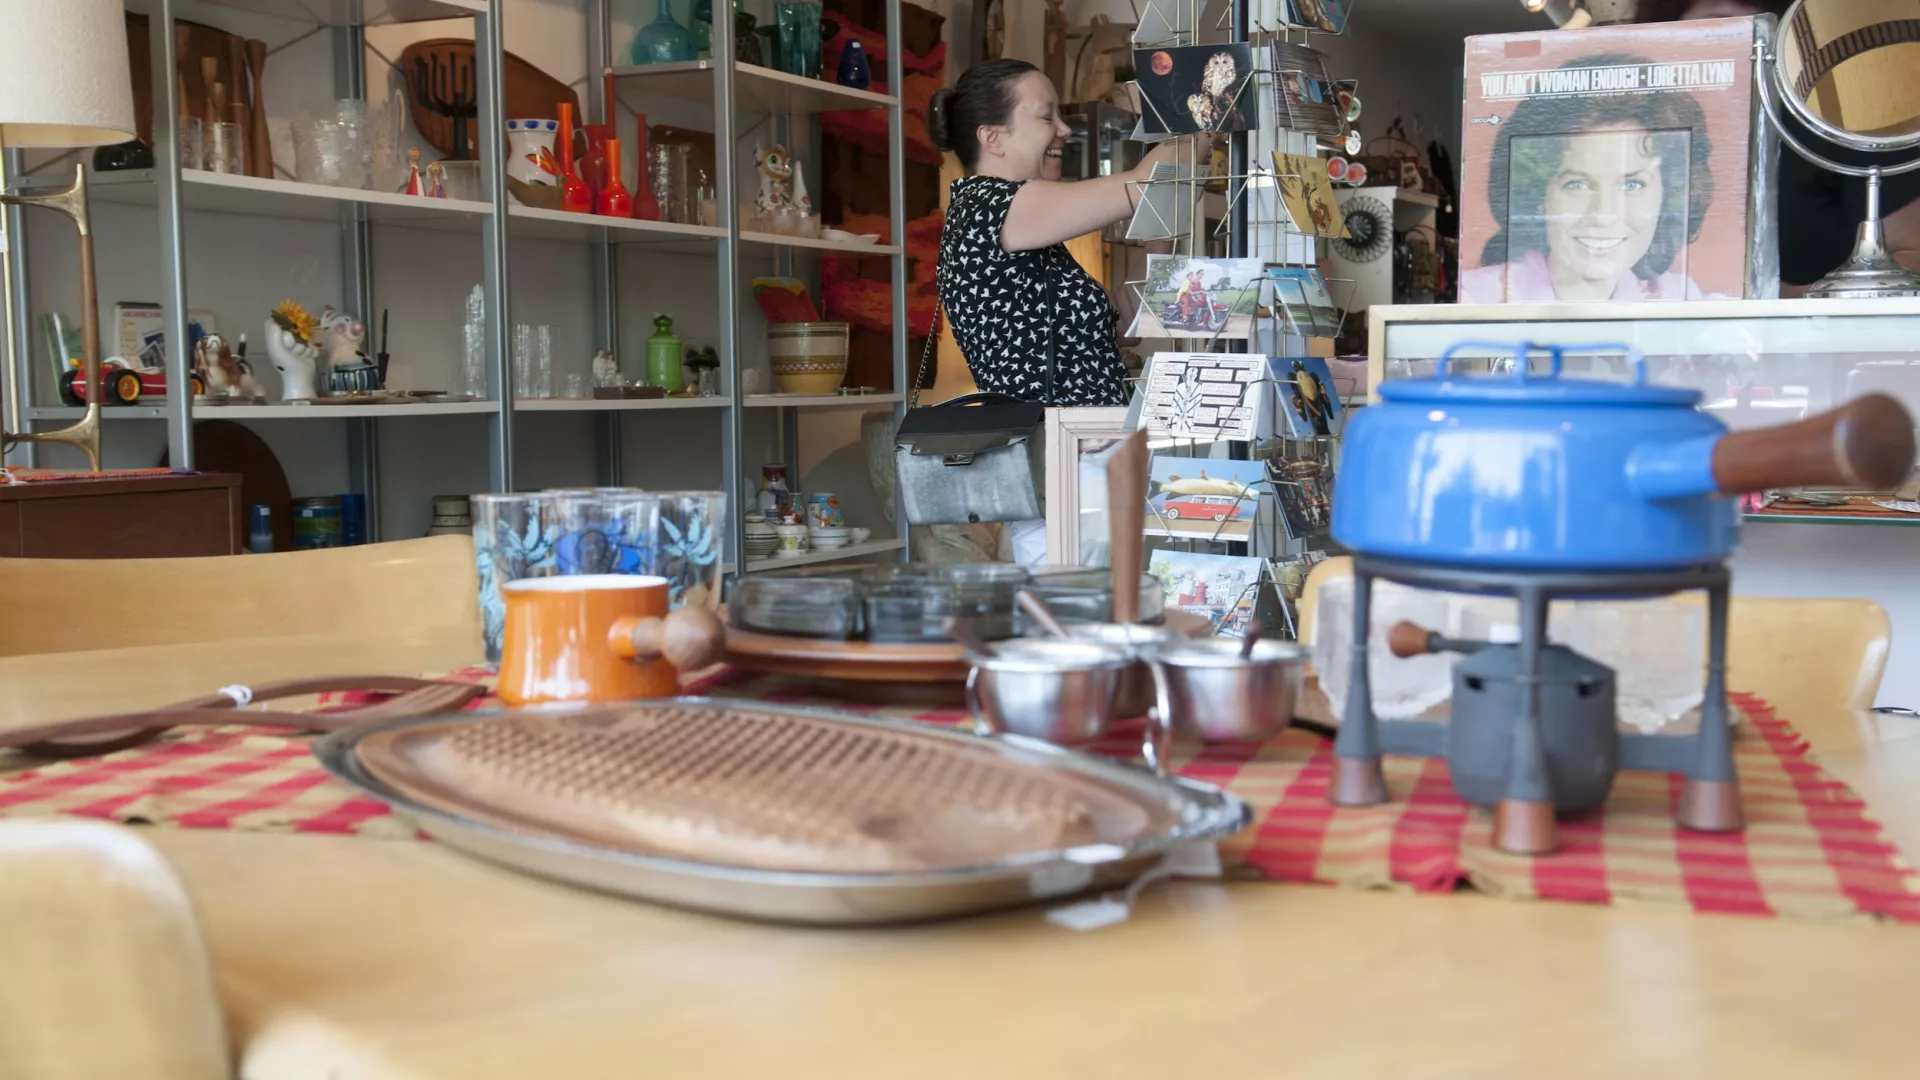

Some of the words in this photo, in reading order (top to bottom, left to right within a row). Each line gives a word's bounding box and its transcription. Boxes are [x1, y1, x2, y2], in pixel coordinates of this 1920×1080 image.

[1481, 75, 1505, 96] YOU
[1505, 73, 1538, 95] AIN'T
[1539, 69, 1590, 93] WOMAN
[1591, 67, 1639, 90] ENOUGH
[1647, 63, 1700, 87] LORETTA
[1702, 61, 1735, 84] LYNN
